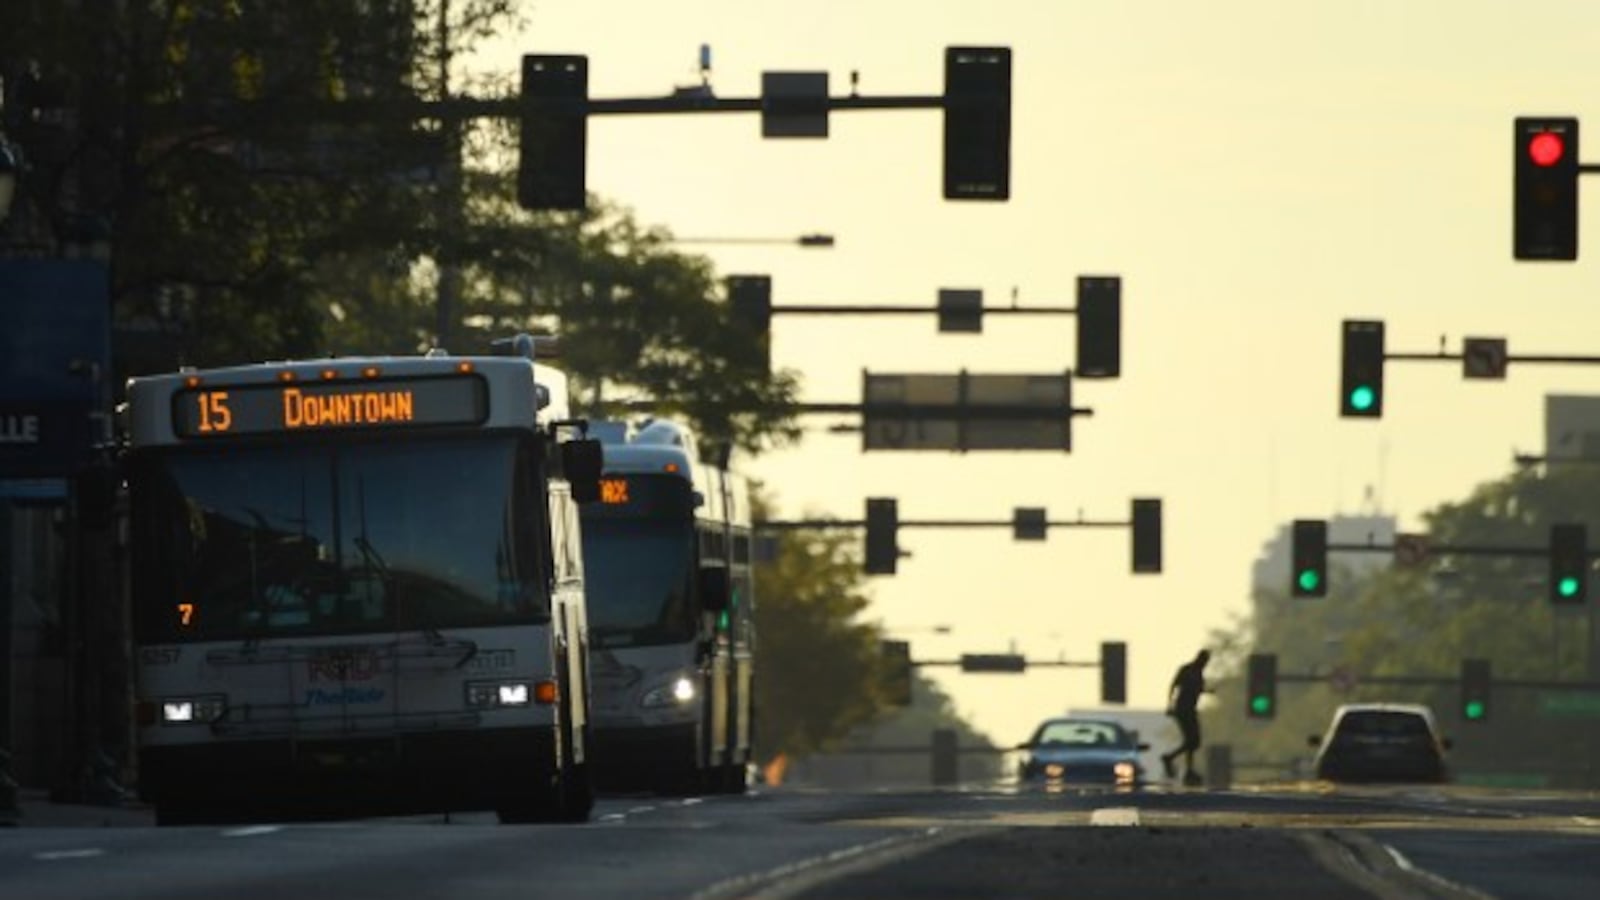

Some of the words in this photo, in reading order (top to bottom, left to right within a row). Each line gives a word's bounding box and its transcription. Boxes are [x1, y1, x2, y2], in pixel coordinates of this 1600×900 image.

[198, 391, 231, 432] 15
[597, 480, 629, 504] AX
[177, 603, 193, 626] 7
